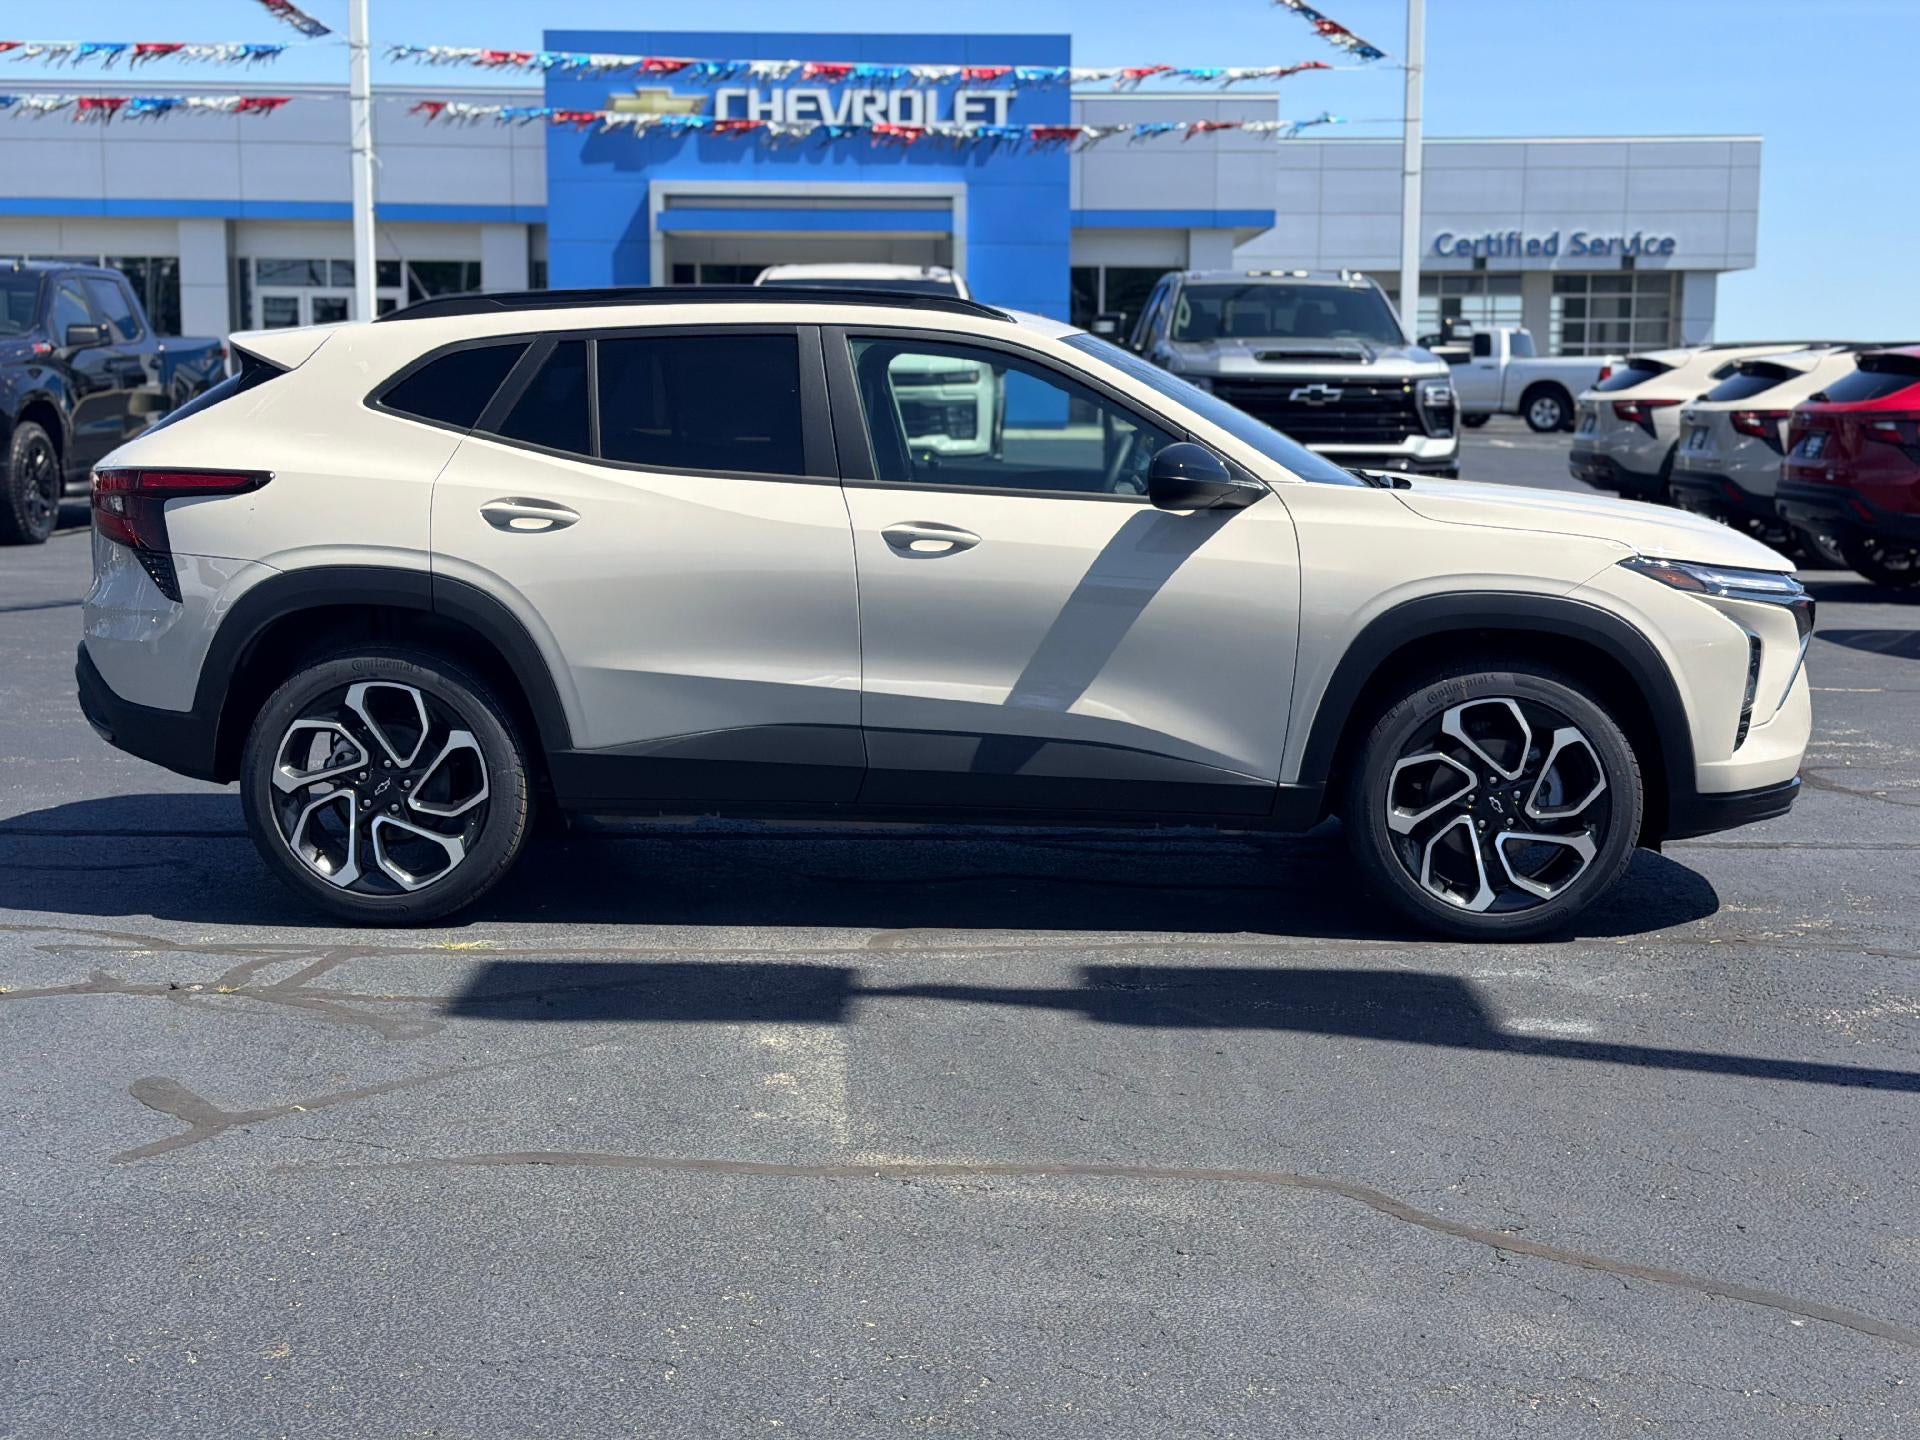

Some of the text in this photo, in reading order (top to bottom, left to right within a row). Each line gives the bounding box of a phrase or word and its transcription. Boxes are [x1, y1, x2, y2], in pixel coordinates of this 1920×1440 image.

[714, 88, 1018, 127] CHEVROLET
[1434, 231, 1676, 257] Certified Service
